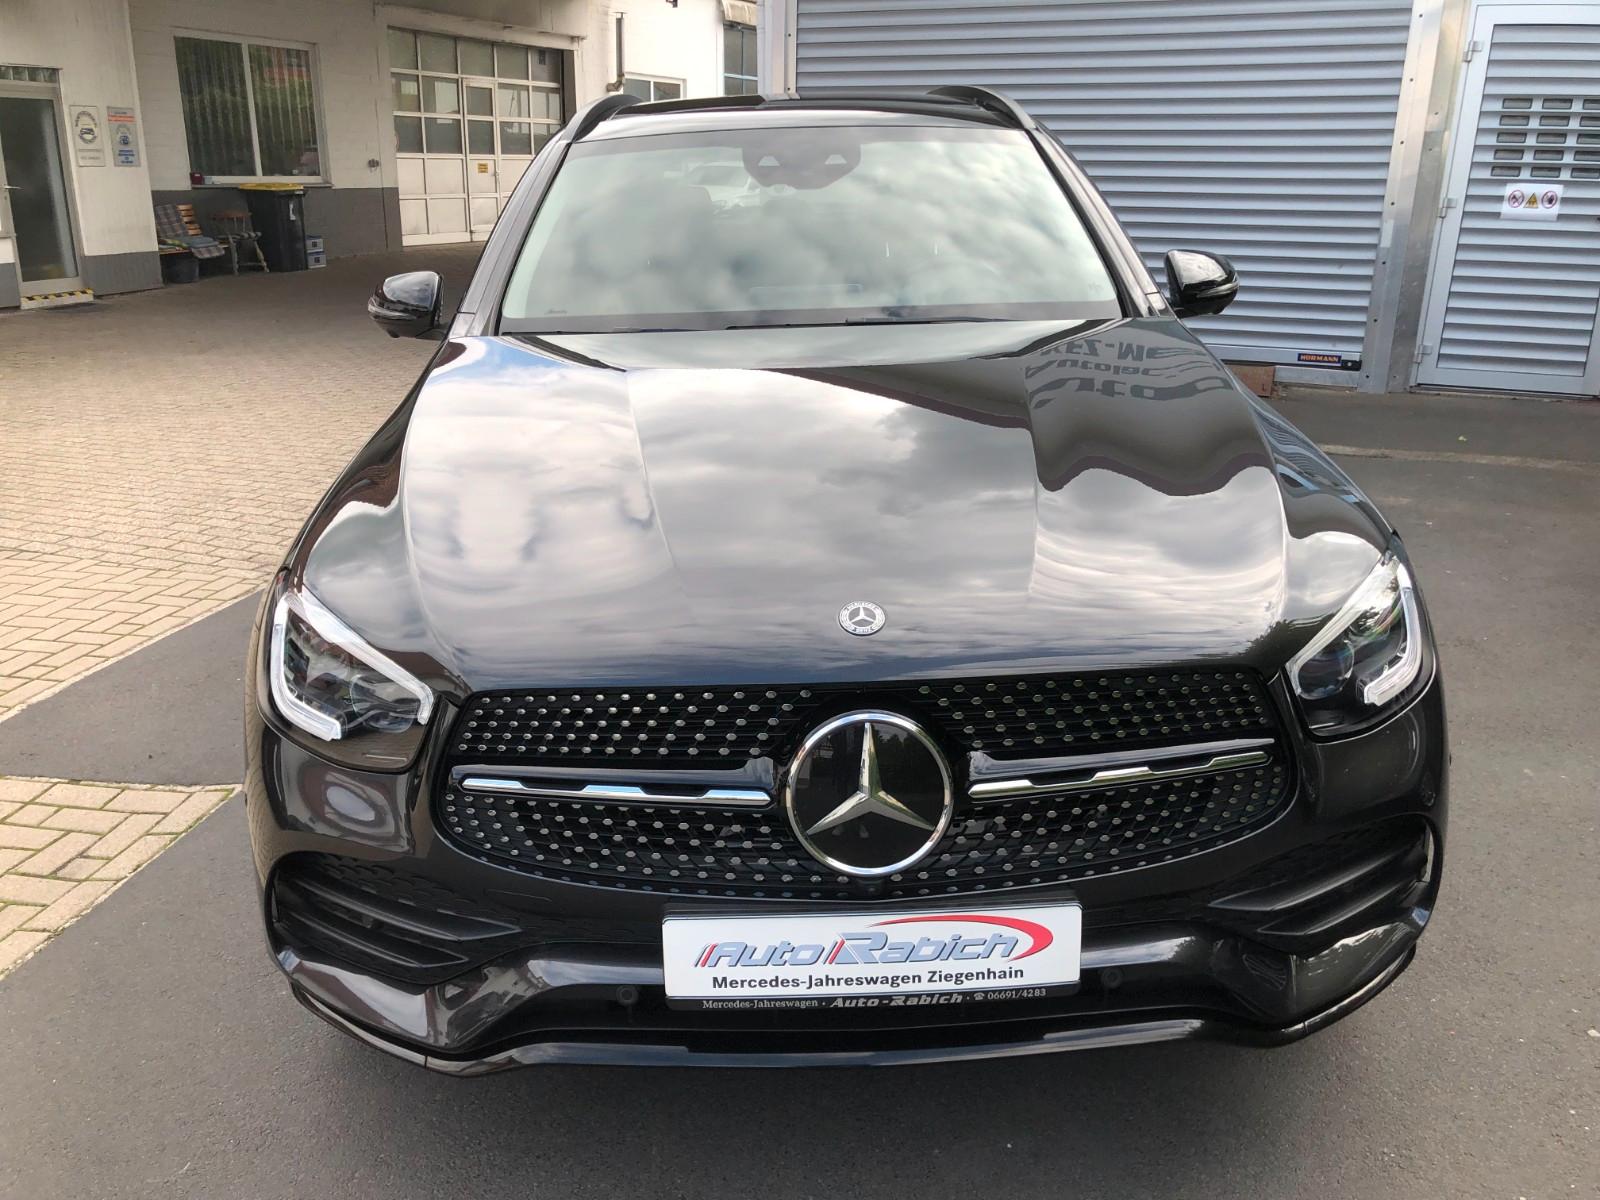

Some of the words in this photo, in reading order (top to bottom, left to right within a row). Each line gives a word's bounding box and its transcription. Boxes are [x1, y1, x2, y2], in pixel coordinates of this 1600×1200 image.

[695, 940, 824, 968] Auto
[825, 932, 1019, 965] Rabich
[712, 974, 922, 989] Mercedes-Jahreswagen
[927, 966, 1024, 986] Ziegenhain
[702, 999, 818, 1009] Mercedes-Jahreswagen
[987, 988, 1046, 1001] 06691/4283
